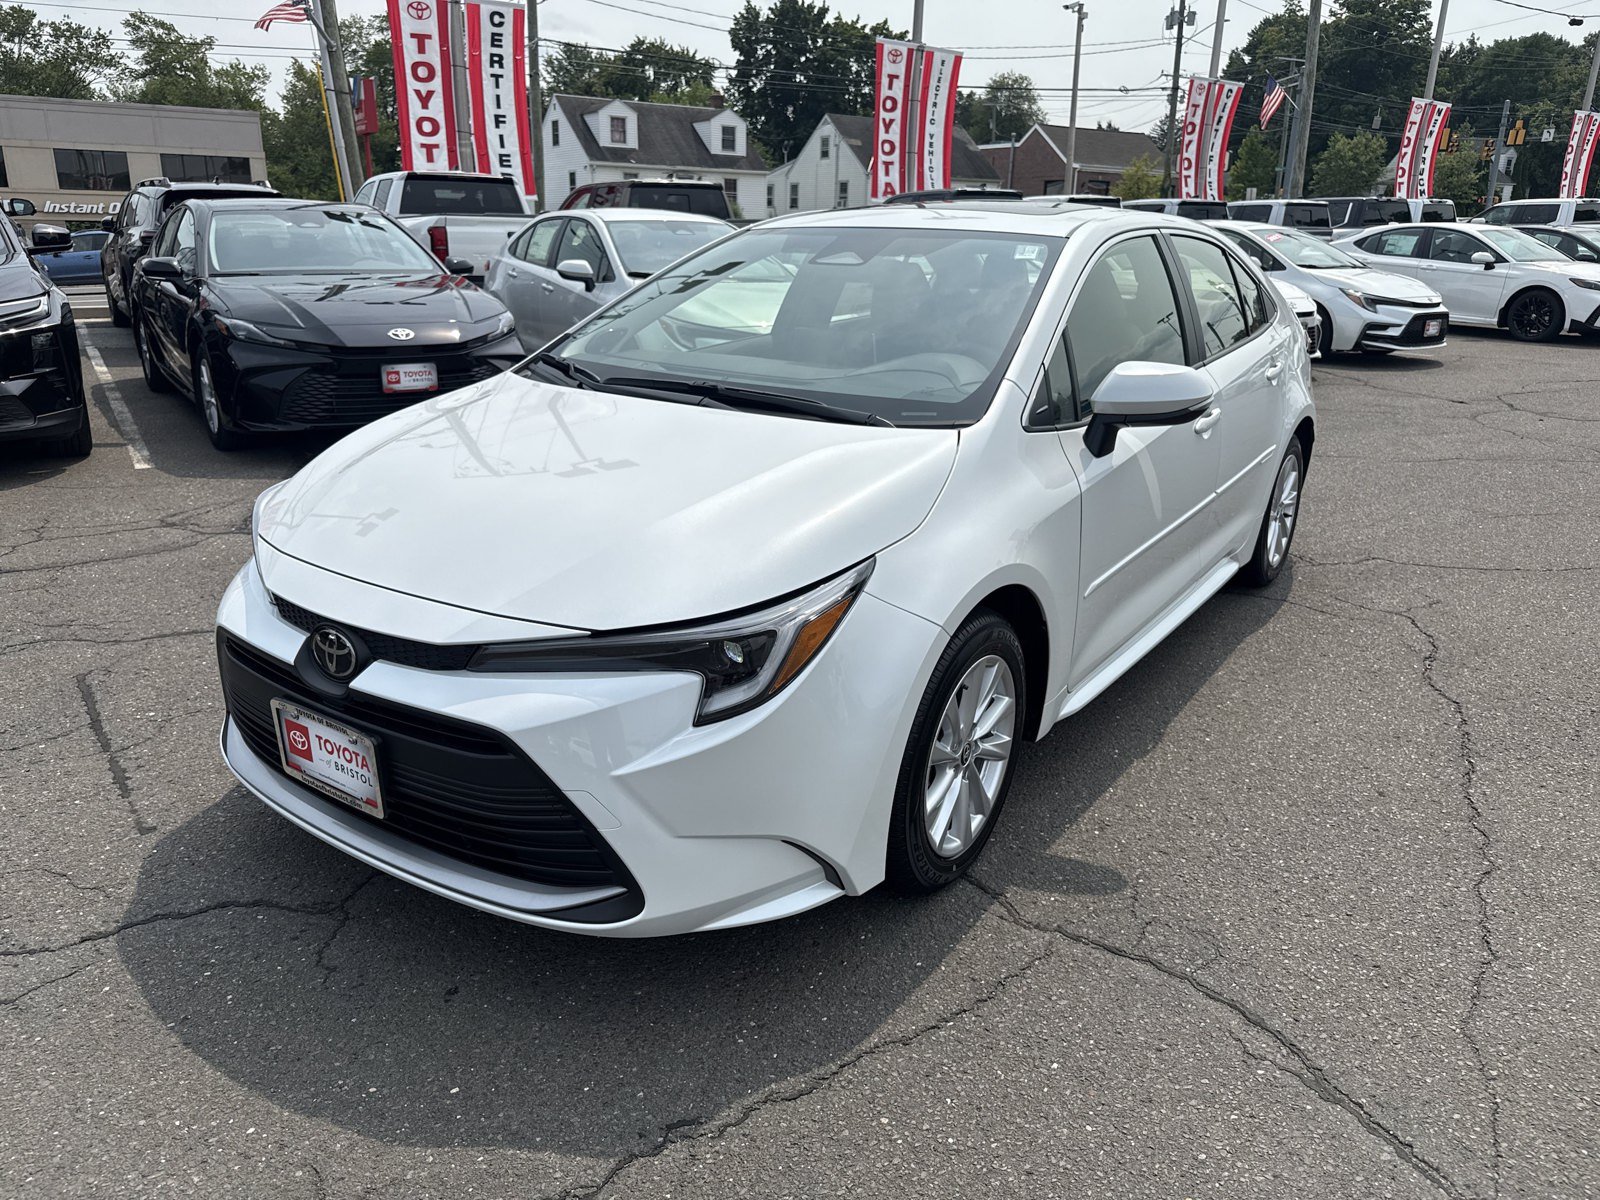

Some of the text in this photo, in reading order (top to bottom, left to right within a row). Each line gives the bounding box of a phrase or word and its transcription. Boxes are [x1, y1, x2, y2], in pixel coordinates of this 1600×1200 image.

[410, 33, 441, 171] TOYOT
[489, 11, 513, 178] CERTIFIE
[927, 59, 946, 189] ELECTRIC VEHICLE
[881, 74, 900, 197] TOYOTA
[1397, 121, 1417, 198] TOYOT
[1560, 131, 1578, 198] TOYOT
[1418, 145, 1429, 197] TRUCK
[43, 201, 106, 214] Instant
[403, 370, 433, 378] TOYOTA
[295, 708, 317, 722] TOYOTA
[315, 734, 371, 773] TOYOTA
[325, 758, 332, 768] of
[334, 761, 373, 787] BRISTOL
